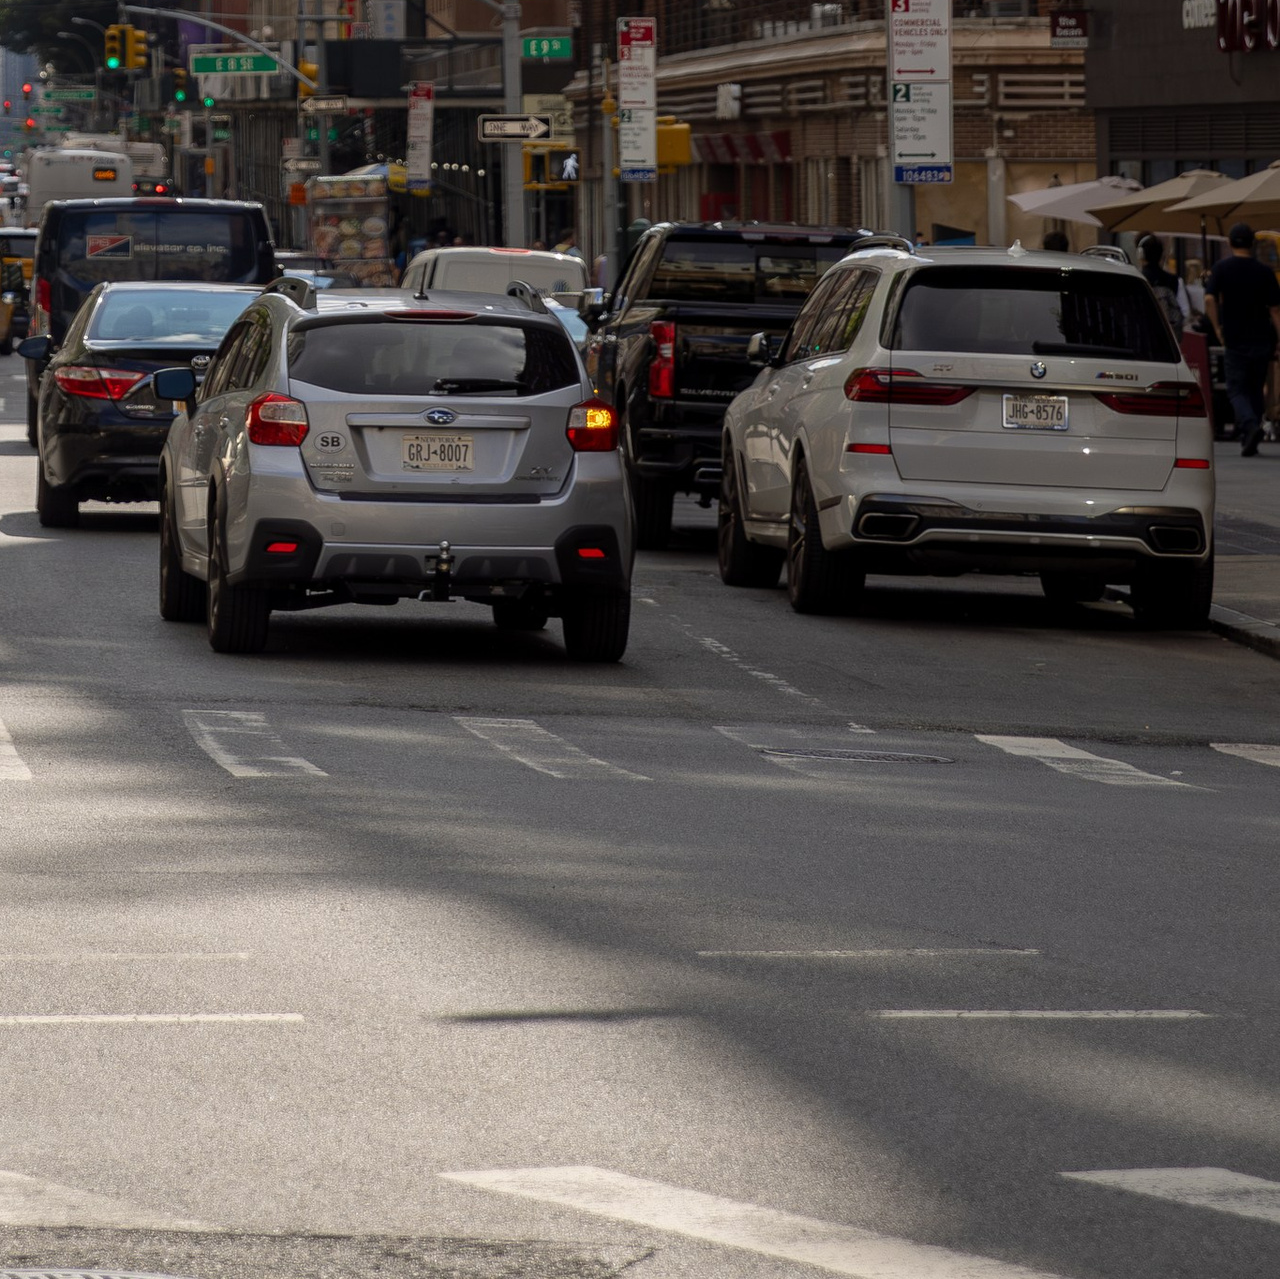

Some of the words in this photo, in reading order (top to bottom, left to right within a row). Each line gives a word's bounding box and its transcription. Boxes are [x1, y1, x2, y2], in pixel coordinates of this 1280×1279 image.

[529, 40, 538, 56] E
[894, 83, 907, 102] 2
[679, 387, 740, 397] SILVERAD
[320, 436, 340, 447] SB
[439, 443, 469, 462] 8007
